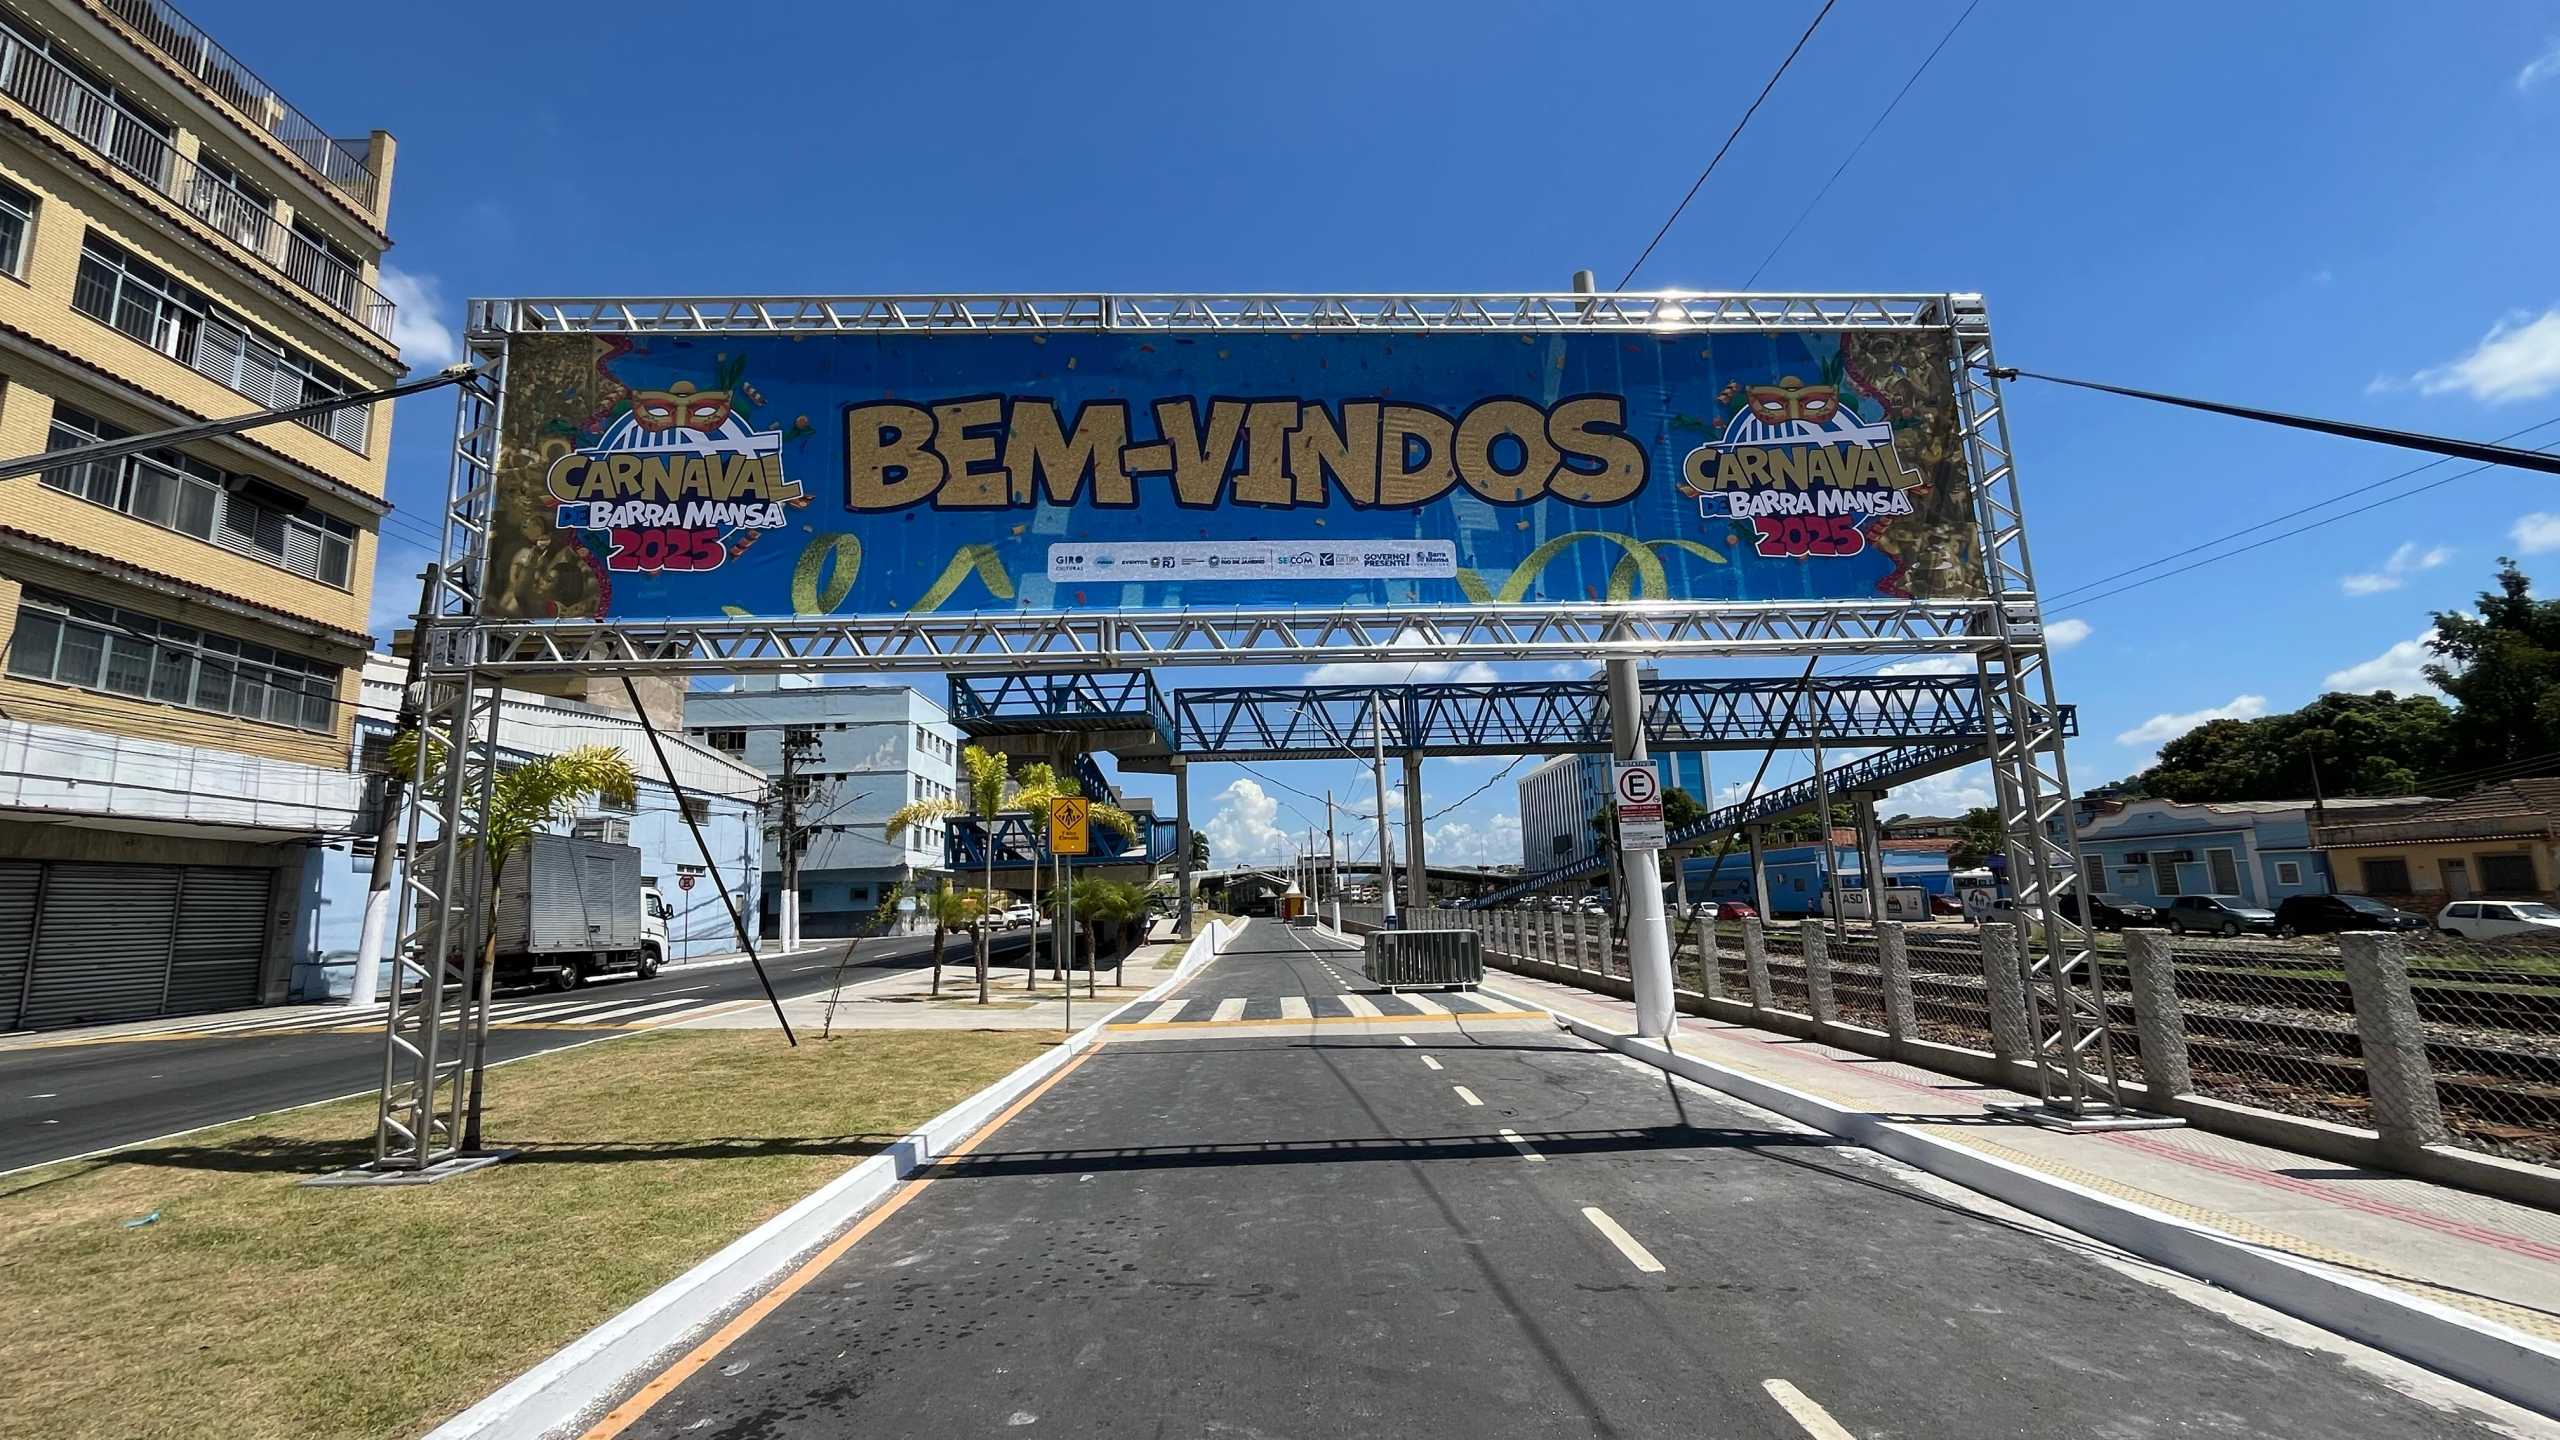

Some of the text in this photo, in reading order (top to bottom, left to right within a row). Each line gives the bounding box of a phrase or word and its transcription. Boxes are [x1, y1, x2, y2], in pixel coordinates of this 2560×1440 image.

[843, 395, 1650, 511] BEM-VINDOS
[1685, 444, 1923, 491] CARNAVAL
[549, 453, 802, 501] CARNAVAL
[590, 501, 681, 528] BARRA
[683, 500, 787, 529] MANSA
[1729, 490, 1816, 517] BARRA
[1817, 489, 1913, 516] MANSA
[608, 528, 725, 571] 2025
[1755, 516, 1864, 555] 2025
[1055, 555, 1084, 565] GIRO
[1628, 775, 1647, 797] E
